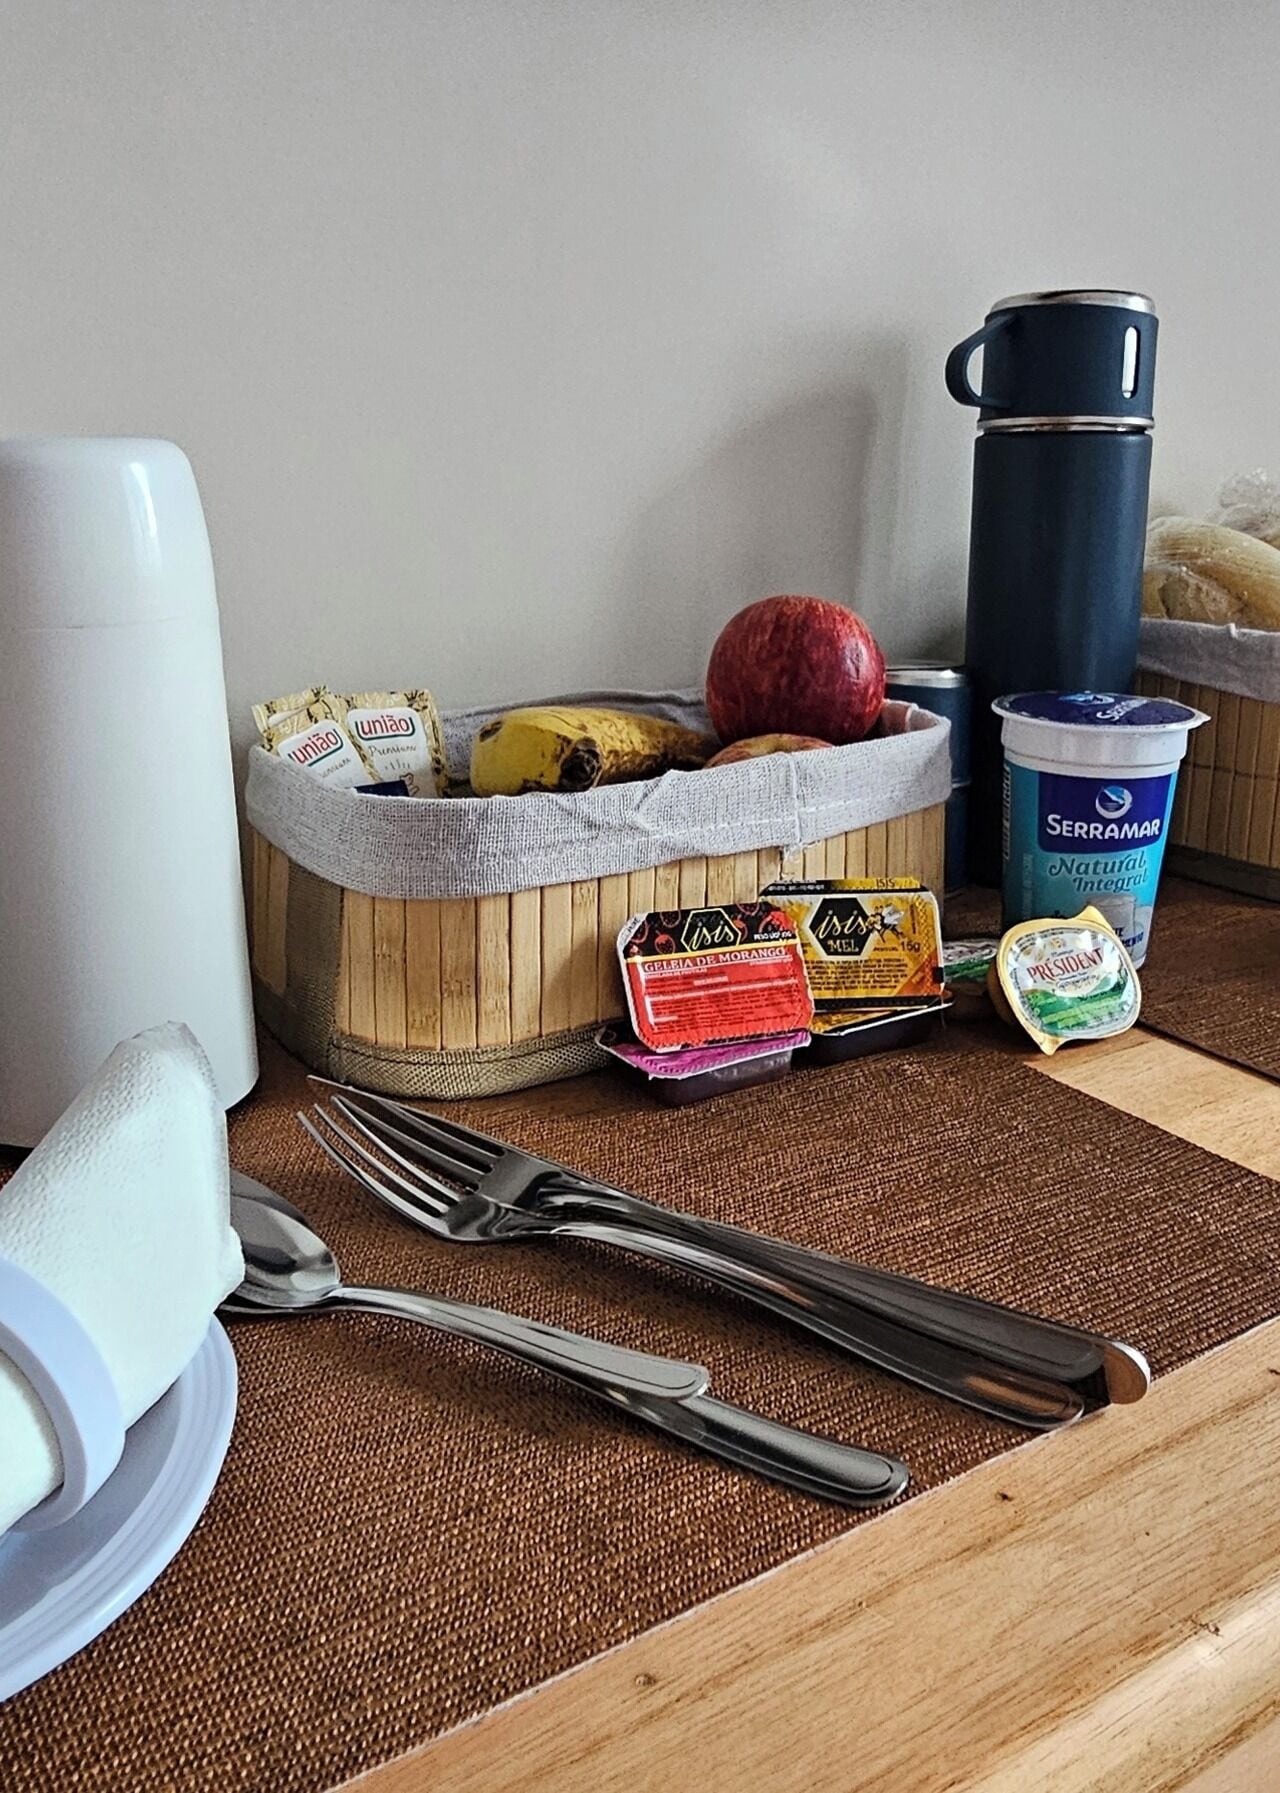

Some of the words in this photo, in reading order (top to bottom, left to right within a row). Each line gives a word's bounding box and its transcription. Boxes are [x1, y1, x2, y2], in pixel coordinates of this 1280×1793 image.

[361, 714, 411, 736] união
[293, 731, 340, 765] união
[1045, 814, 1160, 840] SERRAMAR
[1048, 851, 1147, 876] Natural
[1072, 870, 1147, 893] Integral
[687, 920, 735, 950] isis
[816, 909, 868, 939] isis
[827, 940, 860, 953] MEL
[644, 957, 694, 973] GELEIA
[697, 954, 716, 967] DE
[719, 947, 785, 964] MORANGO
[1026, 946, 1104, 983] PRÉSIDENT
